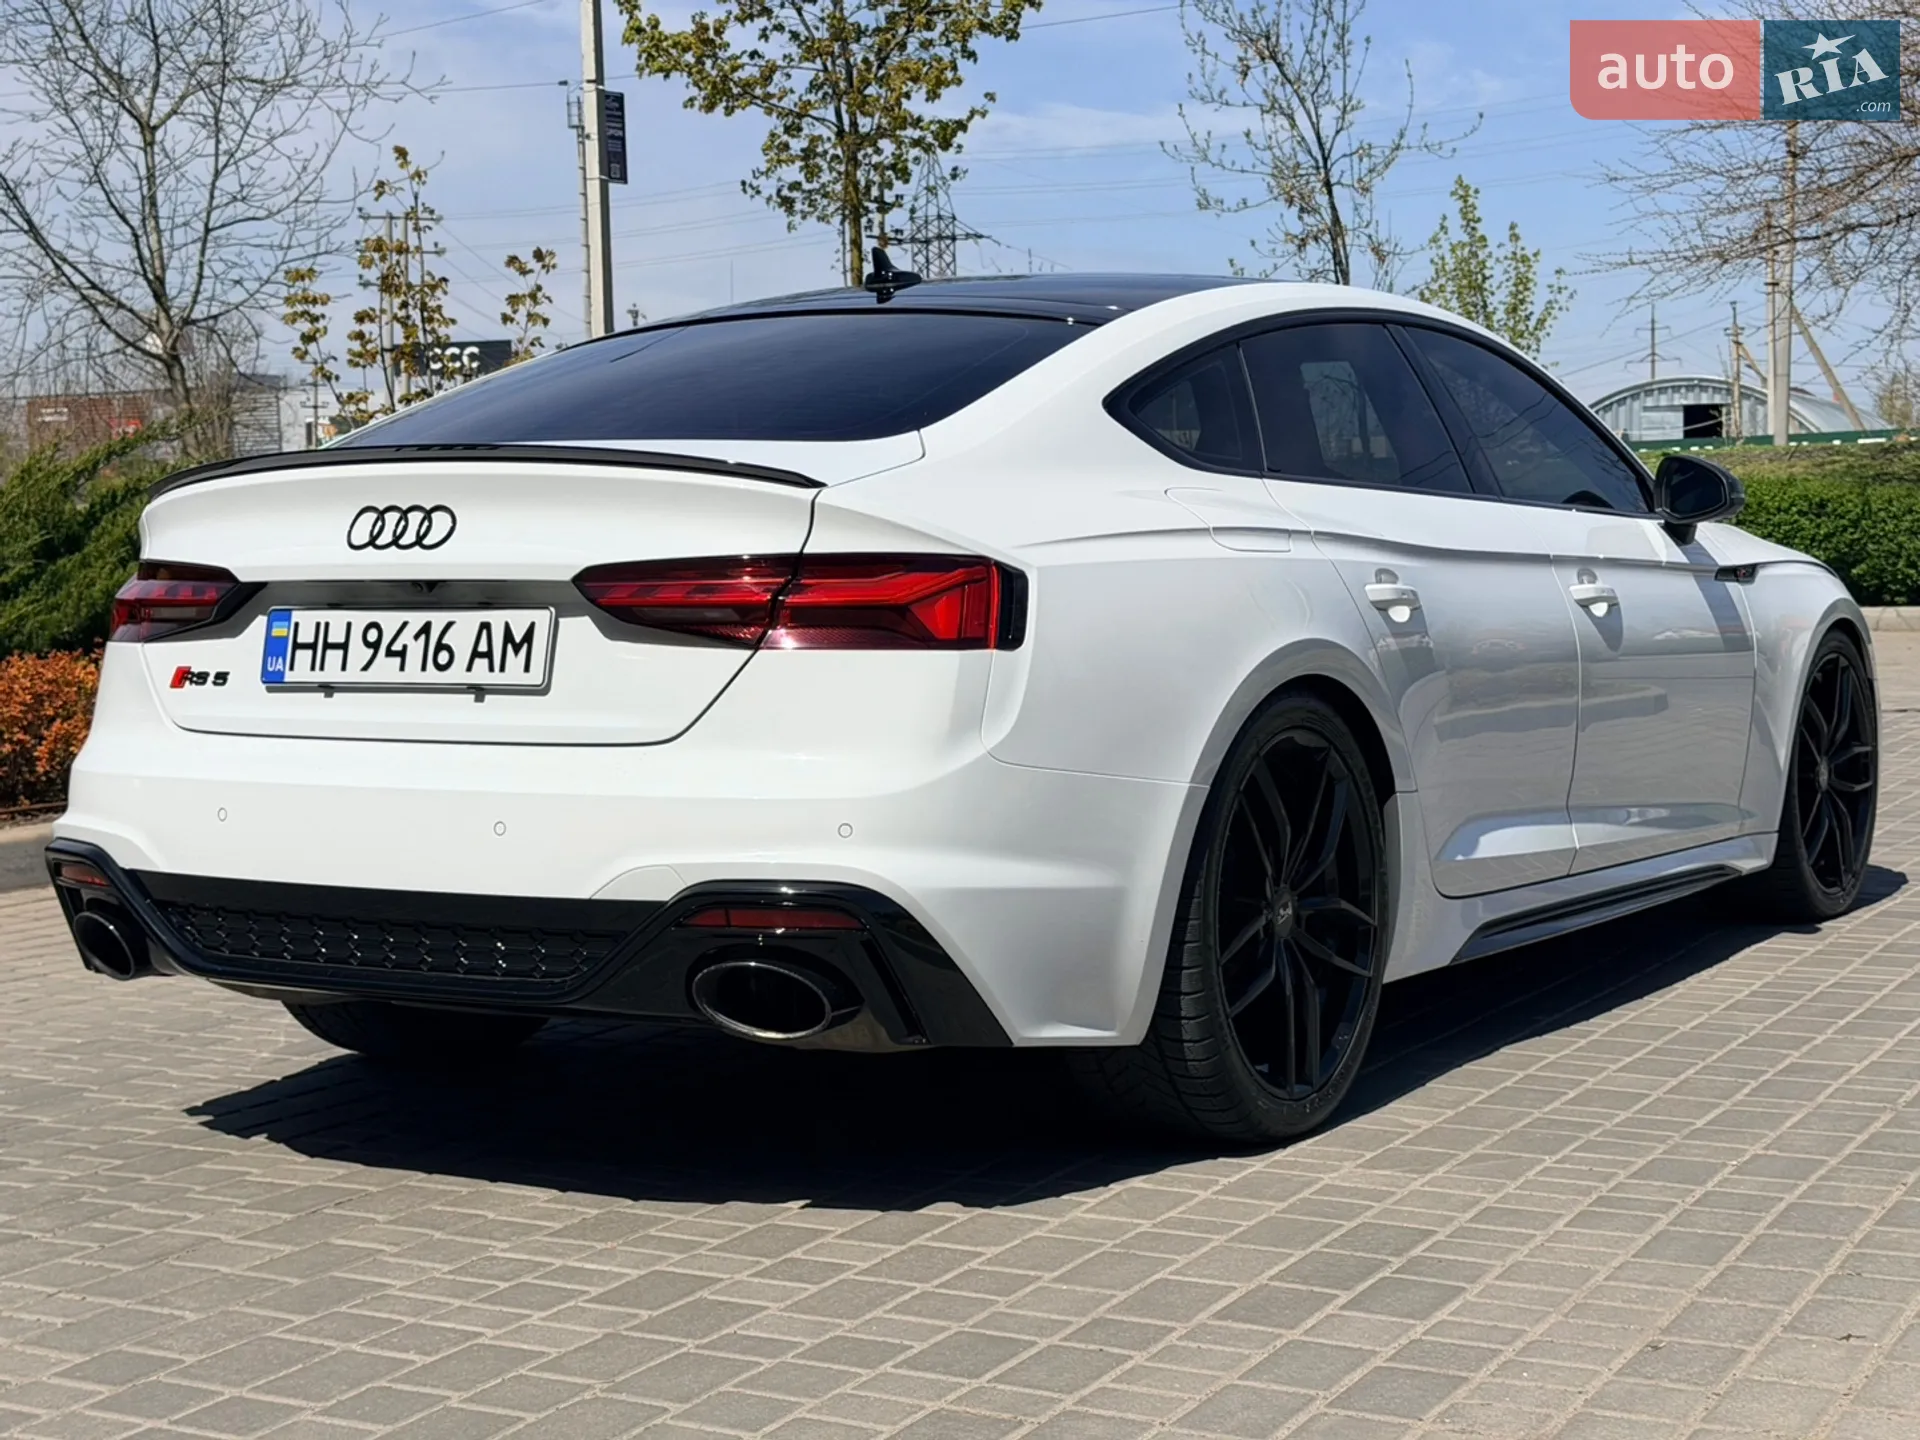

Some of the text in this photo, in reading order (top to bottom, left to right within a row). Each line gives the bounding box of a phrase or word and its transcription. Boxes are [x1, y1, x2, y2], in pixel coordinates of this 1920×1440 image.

[266, 655, 284, 672] UA
[289, 620, 536, 673] HH 9416 AM
